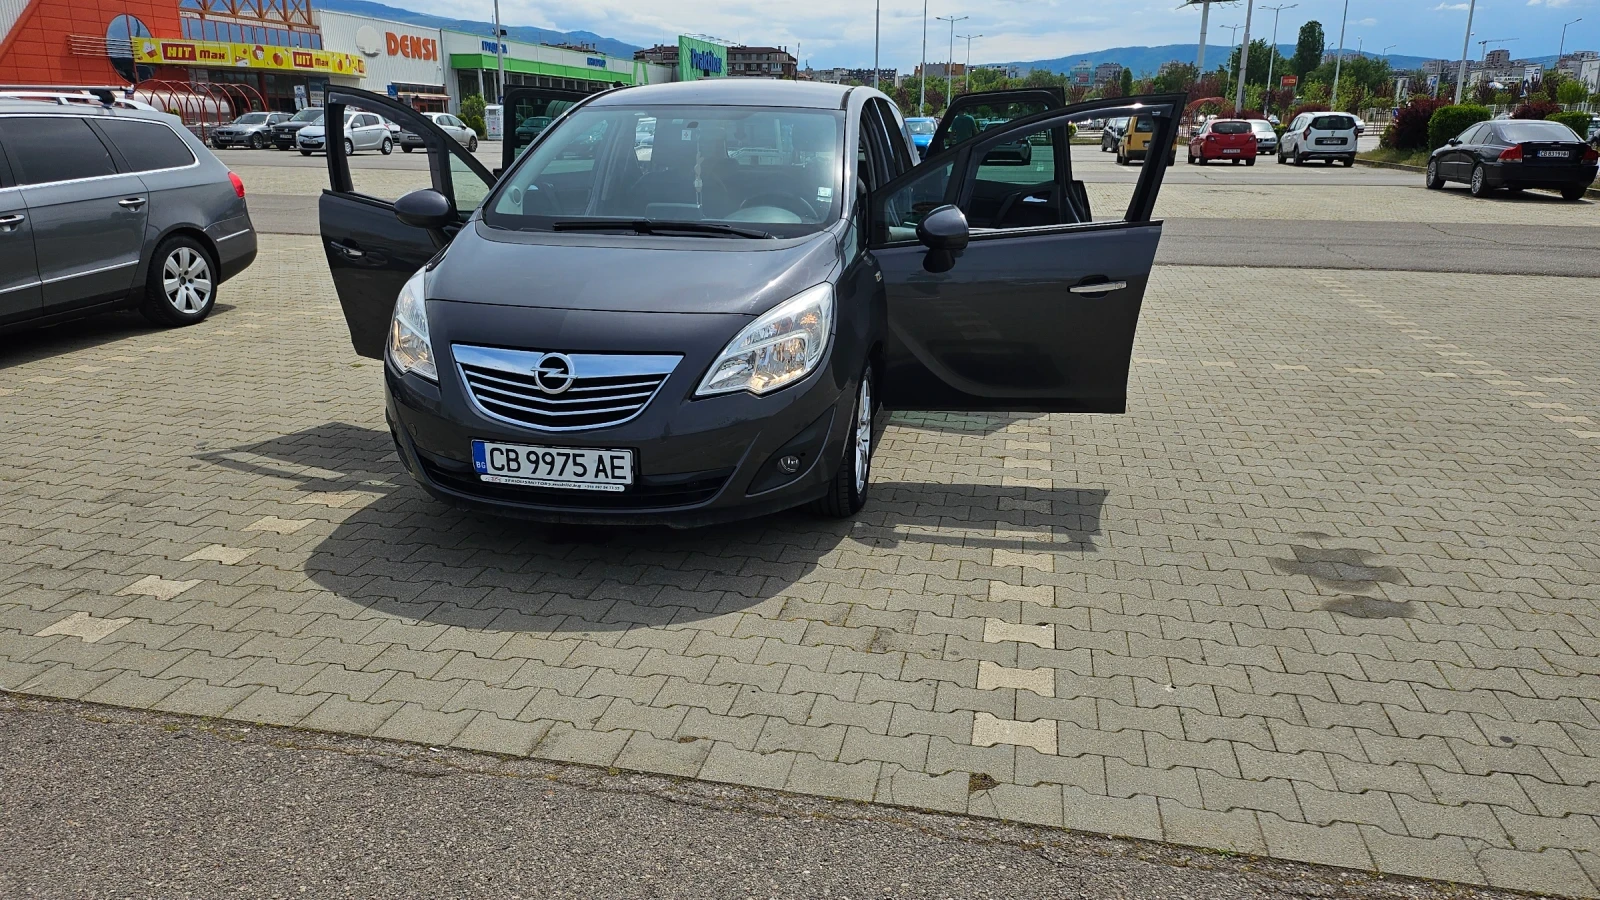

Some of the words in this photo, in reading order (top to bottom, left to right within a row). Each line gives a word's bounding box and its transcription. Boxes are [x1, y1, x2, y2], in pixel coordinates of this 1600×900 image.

[167, 46, 192, 58] HIT
[386, 32, 438, 61] DENSI
[296, 54, 311, 66] HIT
[490, 447, 521, 472] CB
[526, 450, 587, 477] 9975
[594, 454, 627, 480] AE
